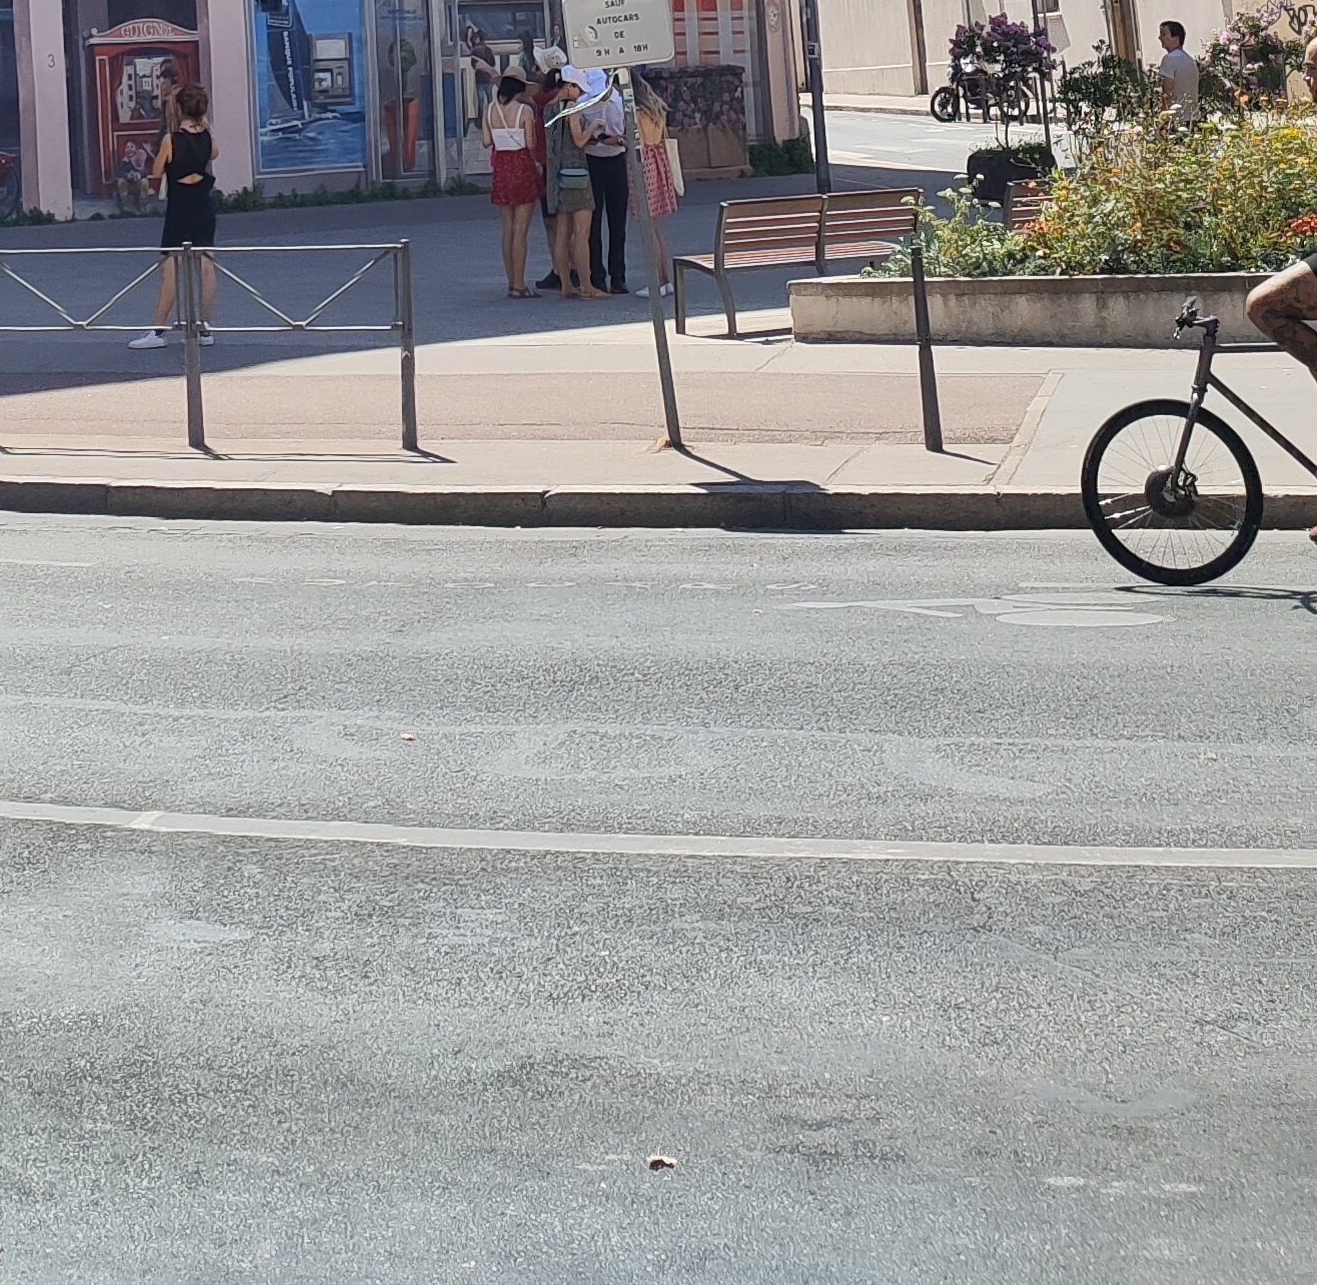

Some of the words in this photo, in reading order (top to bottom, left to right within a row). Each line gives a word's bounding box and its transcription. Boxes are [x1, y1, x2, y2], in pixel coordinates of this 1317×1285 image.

[596, 13, 640, 25] AUTOCARS
[121, 22, 174, 37] GUIGNOL
[614, 30, 625, 39] DE
[47, 53, 56, 68] 3
